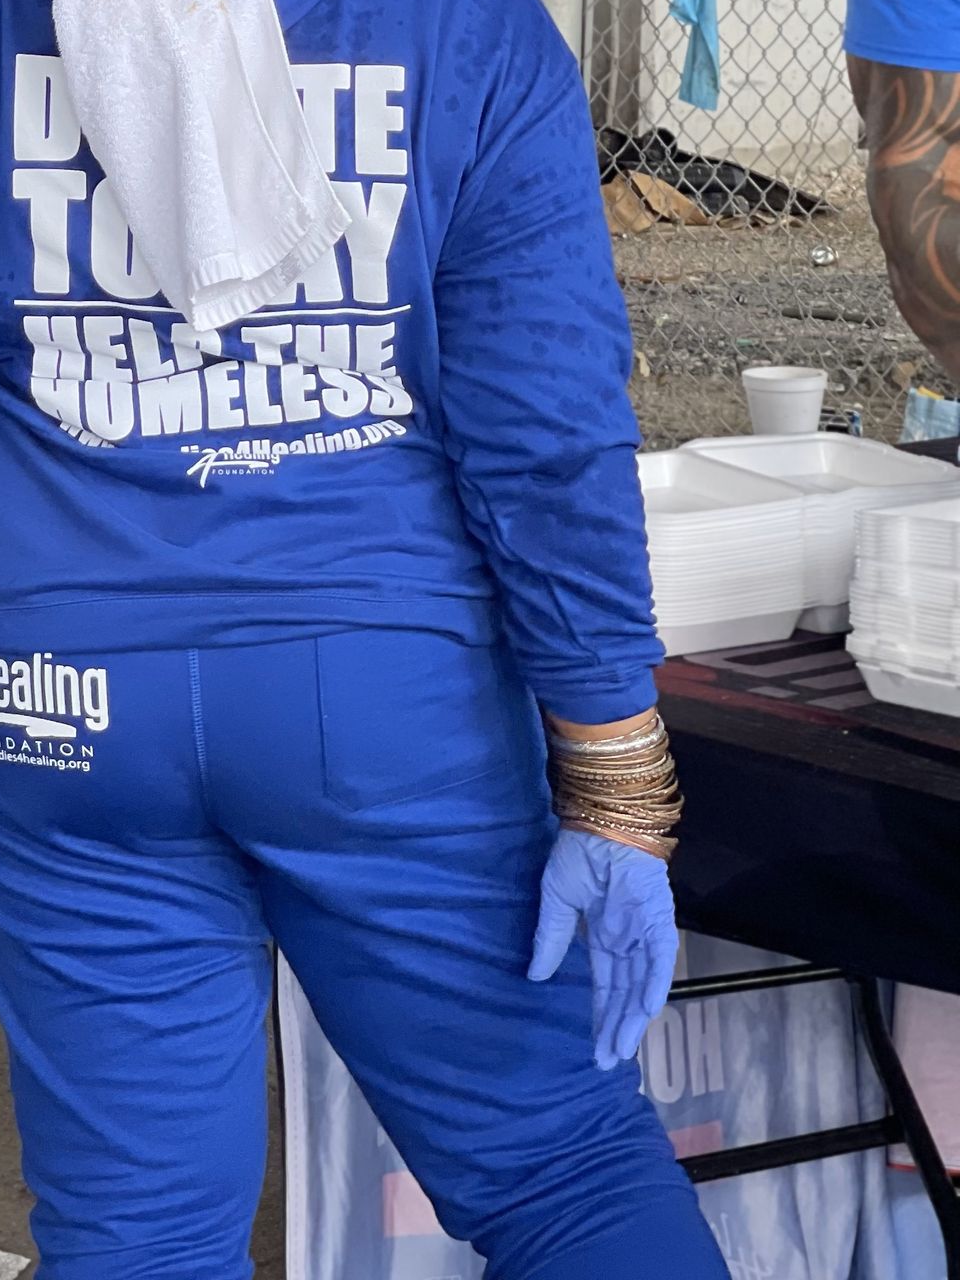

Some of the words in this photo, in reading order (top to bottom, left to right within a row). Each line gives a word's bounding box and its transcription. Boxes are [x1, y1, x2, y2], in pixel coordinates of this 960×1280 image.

[13, 53, 408, 175] DTE
[12, 168, 408, 304] TOY
[23, 316, 222, 384] HELP
[241, 321, 397, 376] THE
[30, 359, 414, 441] HOMELESS
